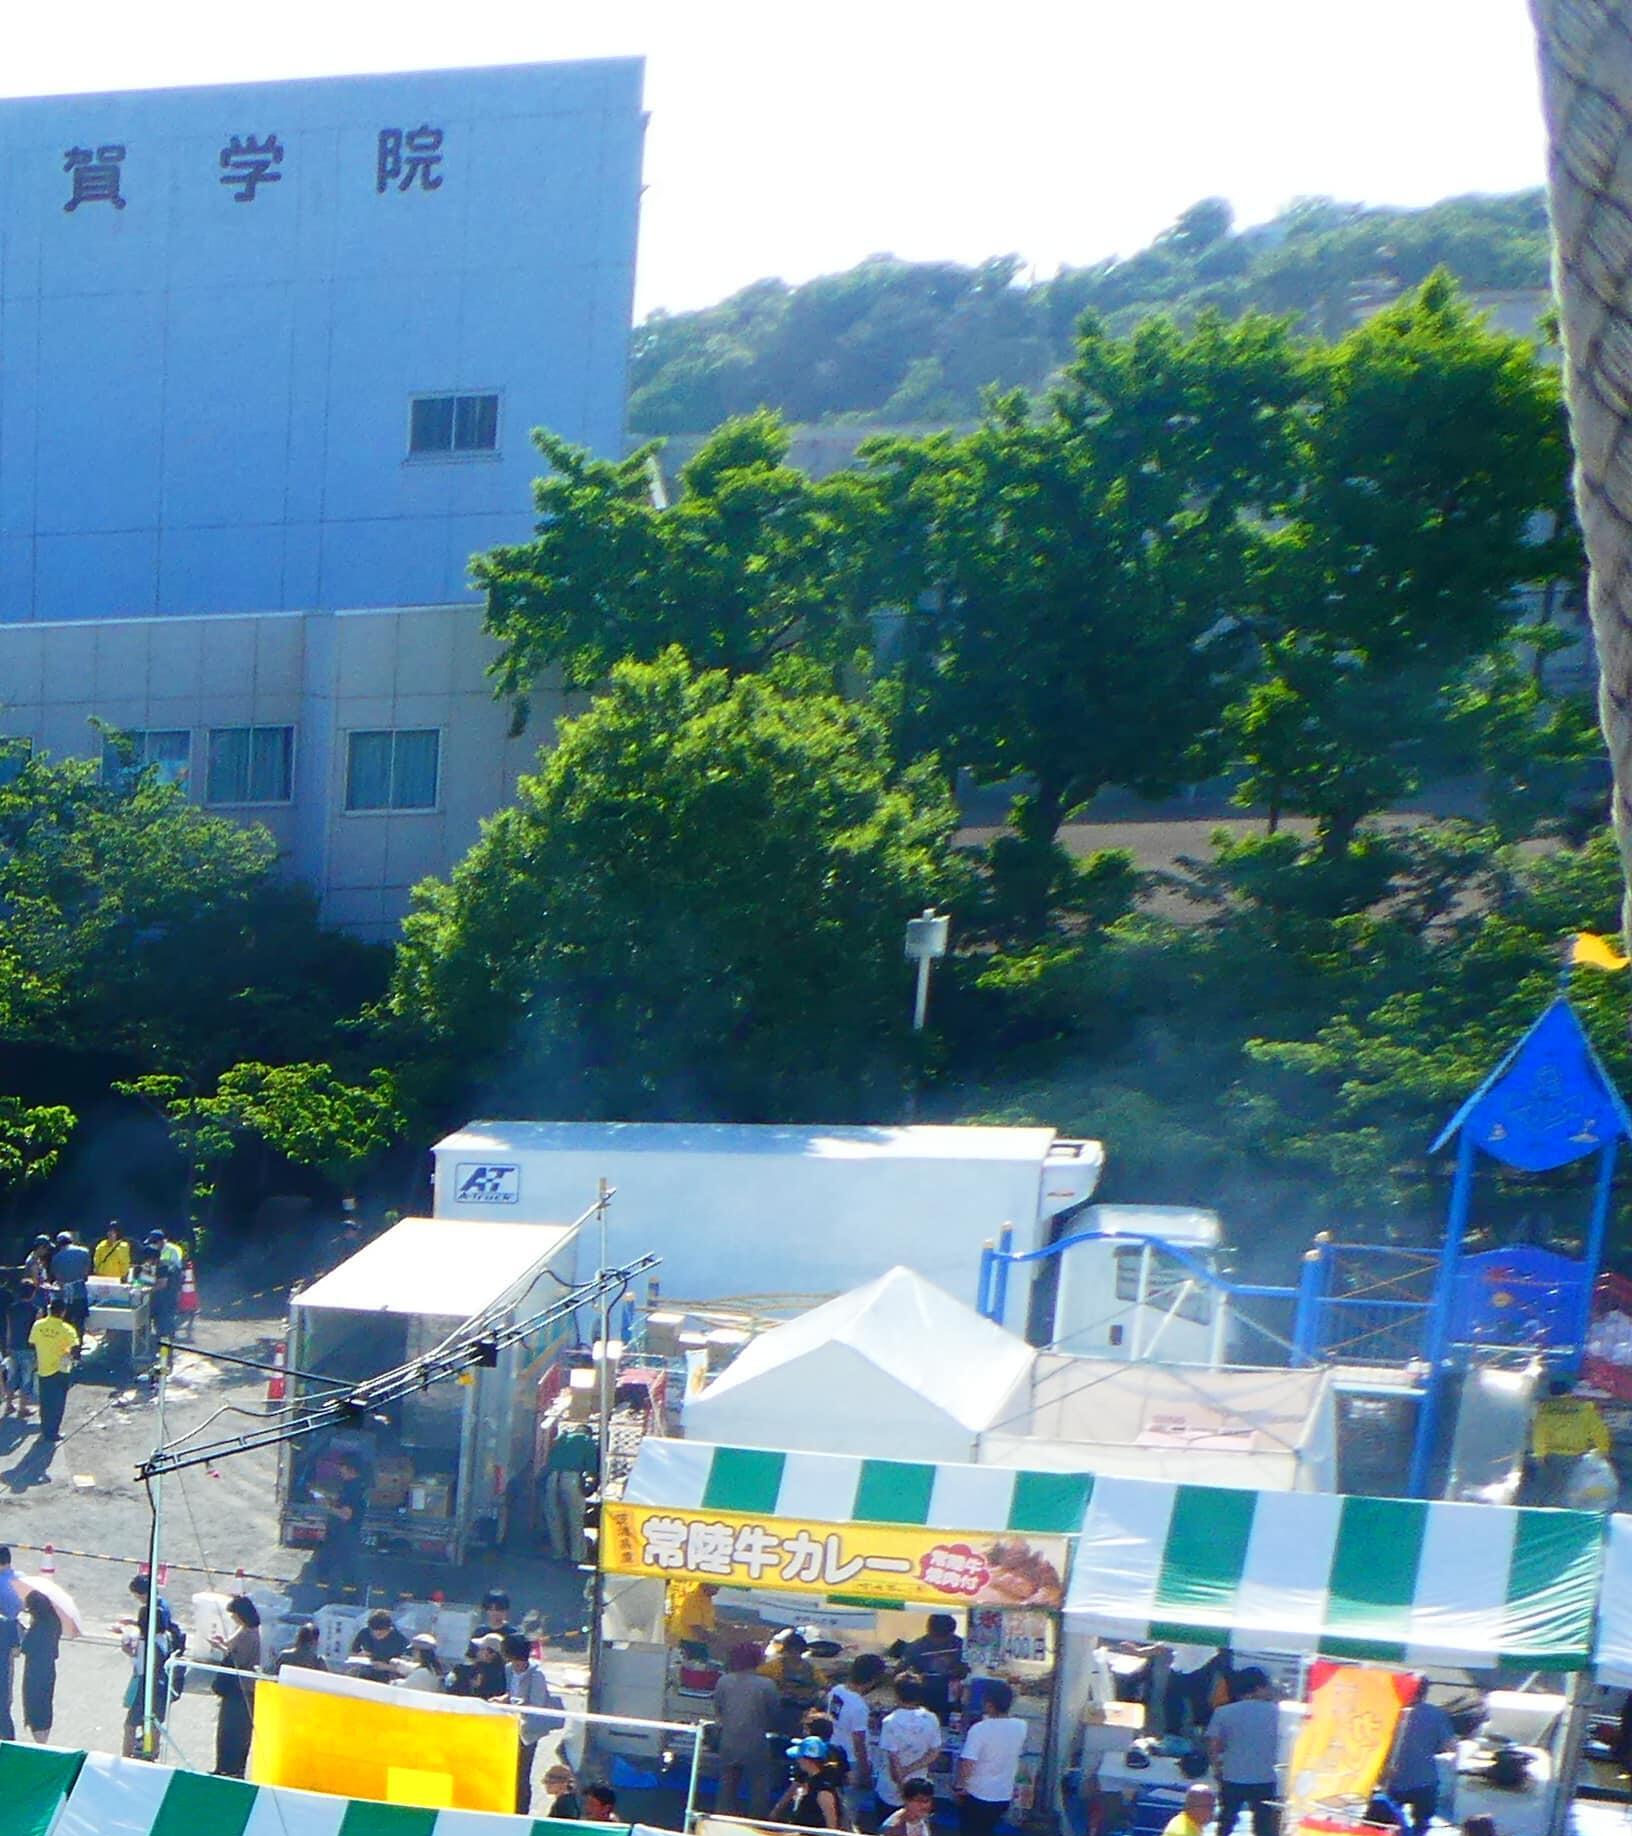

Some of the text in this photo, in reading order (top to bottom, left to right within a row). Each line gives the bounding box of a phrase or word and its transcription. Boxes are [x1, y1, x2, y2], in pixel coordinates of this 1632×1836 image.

[640, 1515, 912, 1585] 常陸牛カレー
